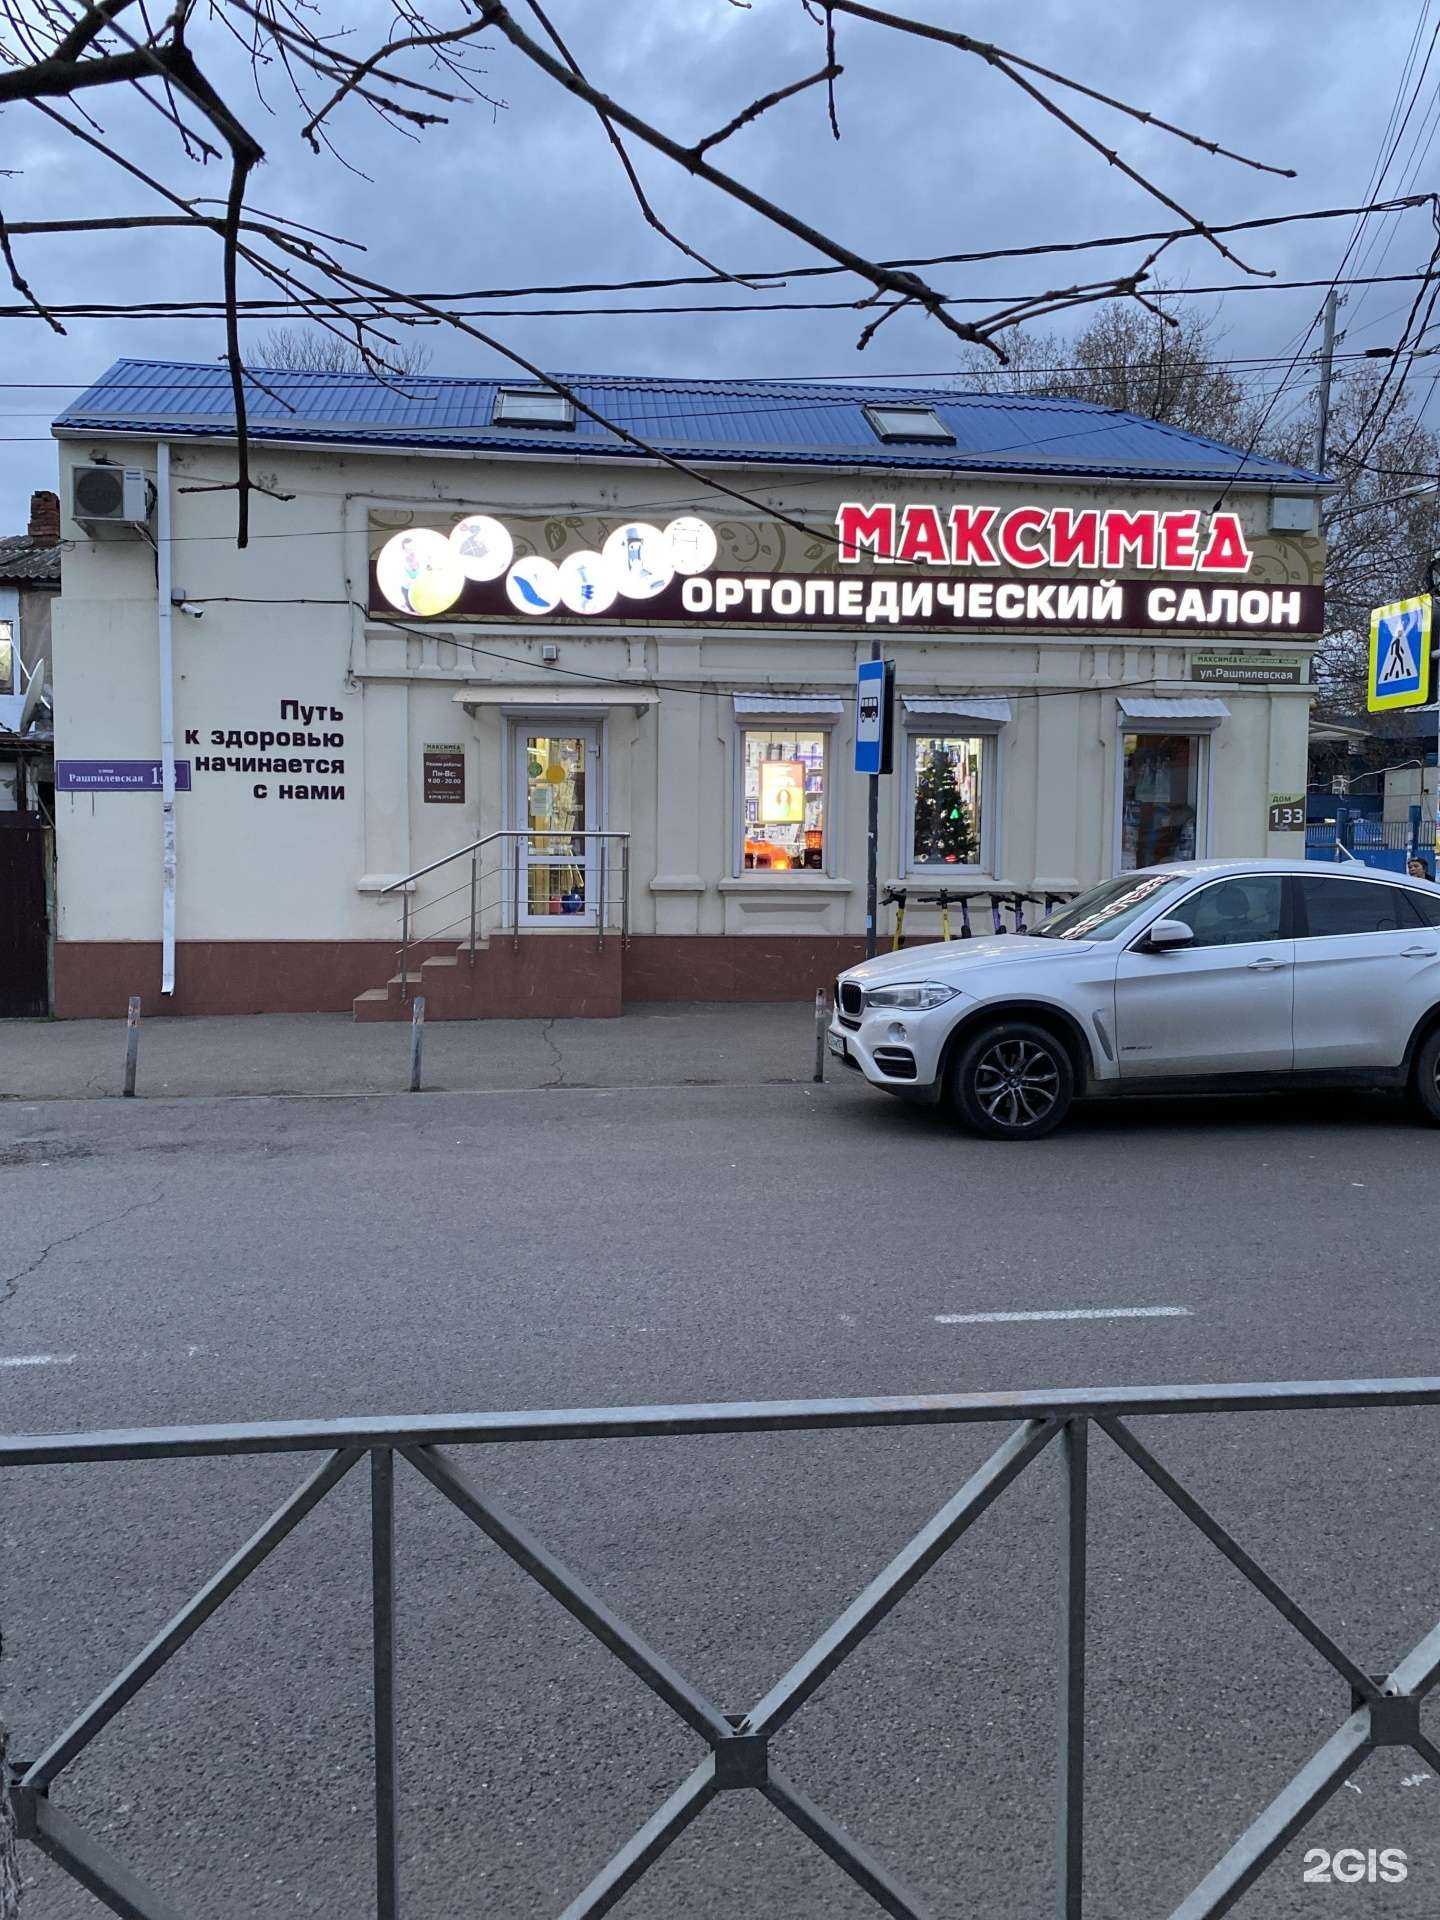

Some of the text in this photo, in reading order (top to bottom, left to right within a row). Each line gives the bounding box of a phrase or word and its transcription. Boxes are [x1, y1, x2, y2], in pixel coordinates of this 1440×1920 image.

[835, 503, 1253, 573] МАКСИМЕД
[682, 577, 1301, 624] ОРТОПЕДИЧЕСКИЙ САЛОН
[1200, 668, 1293, 680] ул.Рашпилевская
[281, 700, 344, 725] Путь
[185, 729, 344, 751] к здоровью
[195, 757, 345, 774] начинается
[69, 773, 144, 783] Рашпилевская
[253, 784, 345, 800] с нами
[1272, 808, 1304, 824] 133
